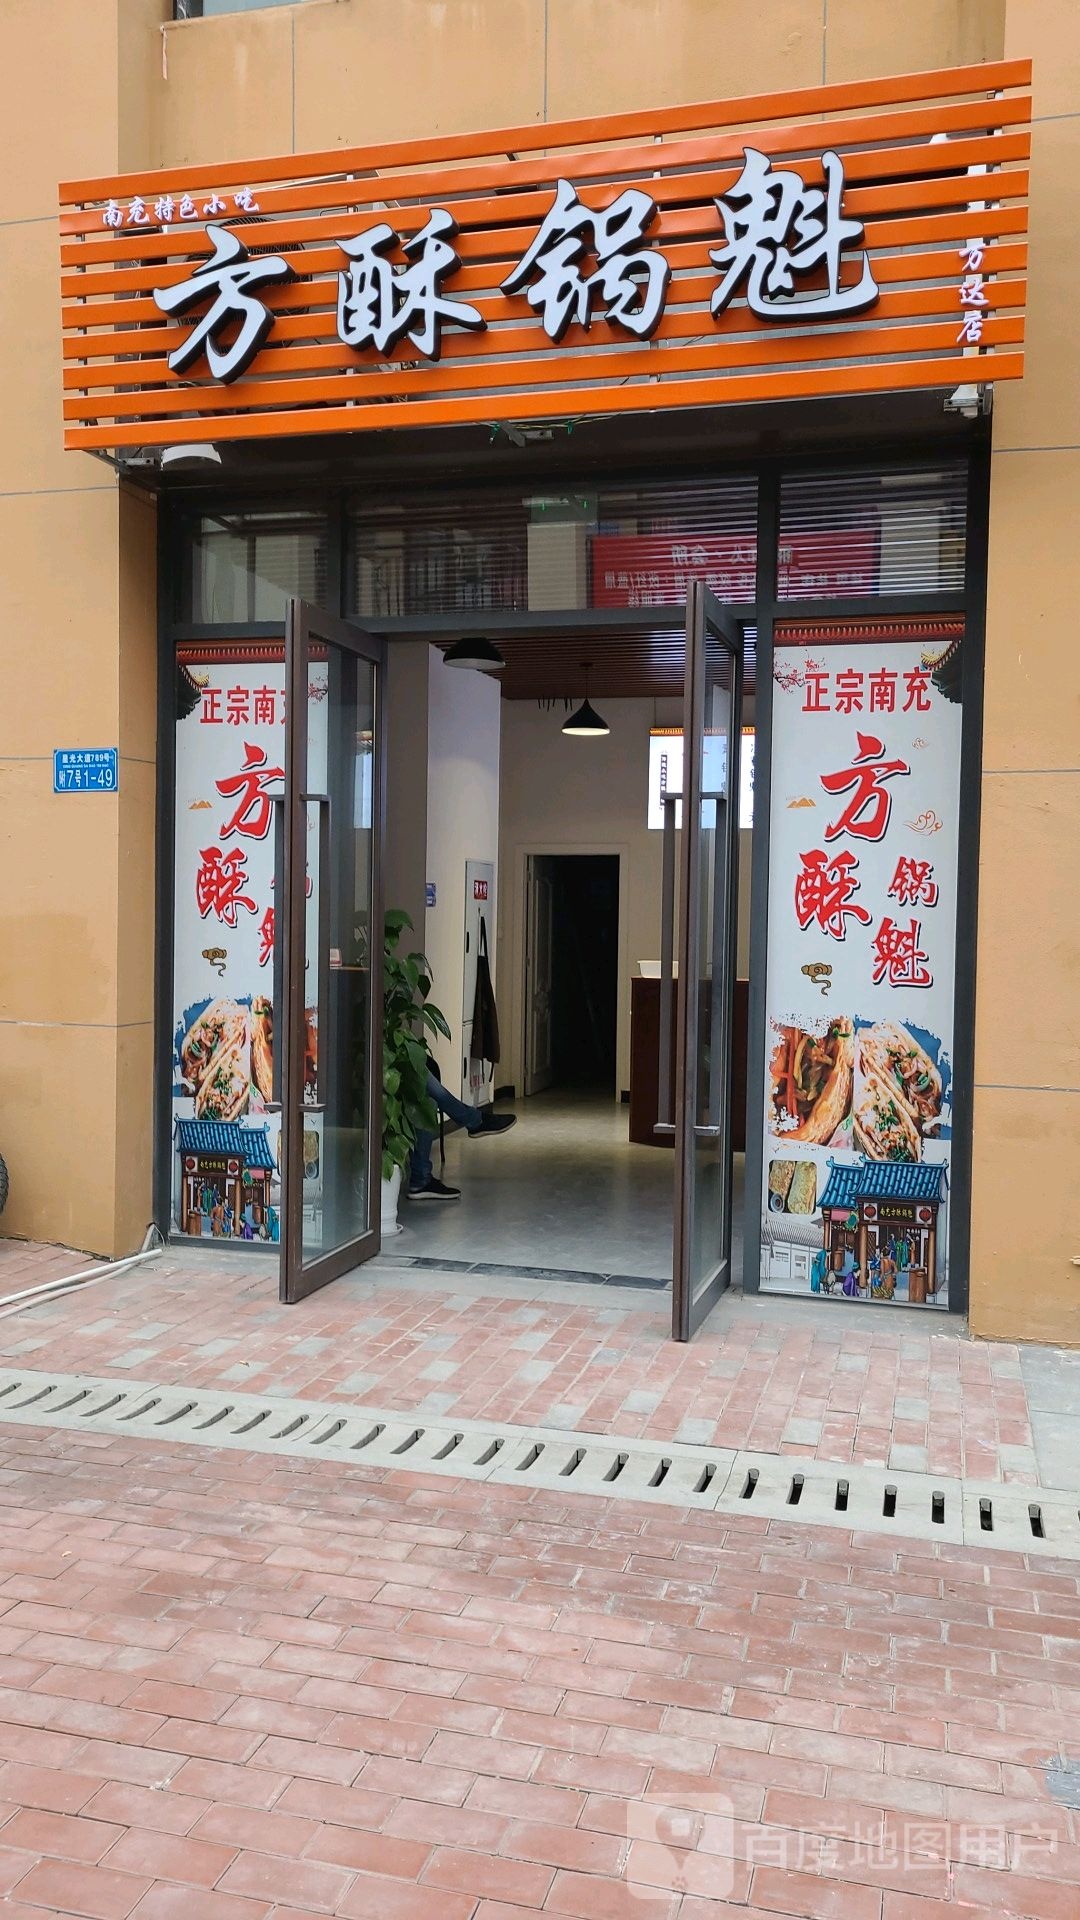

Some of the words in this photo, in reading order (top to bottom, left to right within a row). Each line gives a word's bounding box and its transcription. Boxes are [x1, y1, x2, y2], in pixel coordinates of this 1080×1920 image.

[103, 186, 260, 228] 南充特色小吃
[153, 148, 880, 384] 方酥锅魁
[200, 685, 286, 725] 正宗南
[802, 667, 932, 713] 正宗南充
